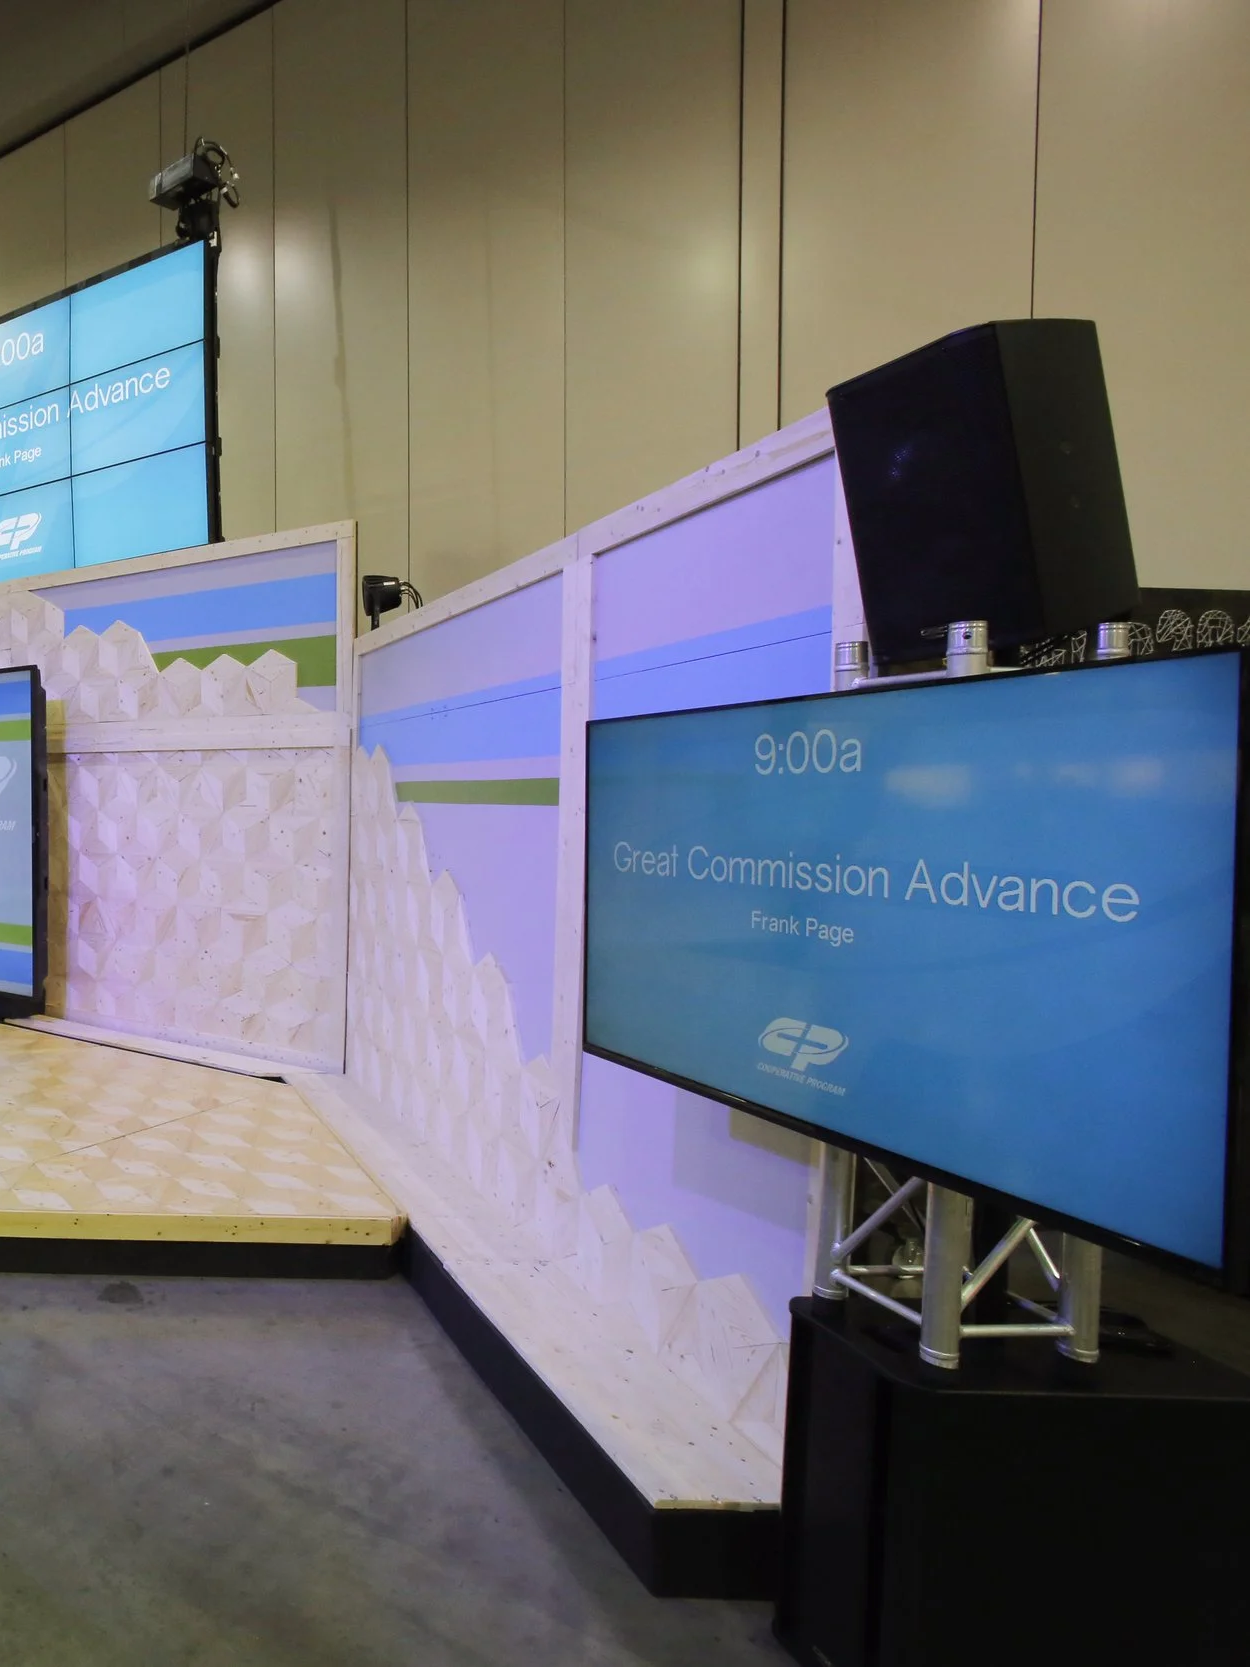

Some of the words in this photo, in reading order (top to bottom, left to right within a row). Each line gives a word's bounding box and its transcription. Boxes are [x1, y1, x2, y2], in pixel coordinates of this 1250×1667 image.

[67, 367, 171, 418] Advance
[14, 445, 42, 465] Page
[754, 729, 861, 775] 9:00a
[614, 841, 678, 877] Great
[688, 846, 889, 898] Commission
[905, 859, 1140, 923] Advance
[751, 911, 800, 936] Frank
[805, 917, 855, 947] Page
[756, 1062, 806, 1084] COOPERATIVE
[806, 1077, 847, 1097] PROGRAM
